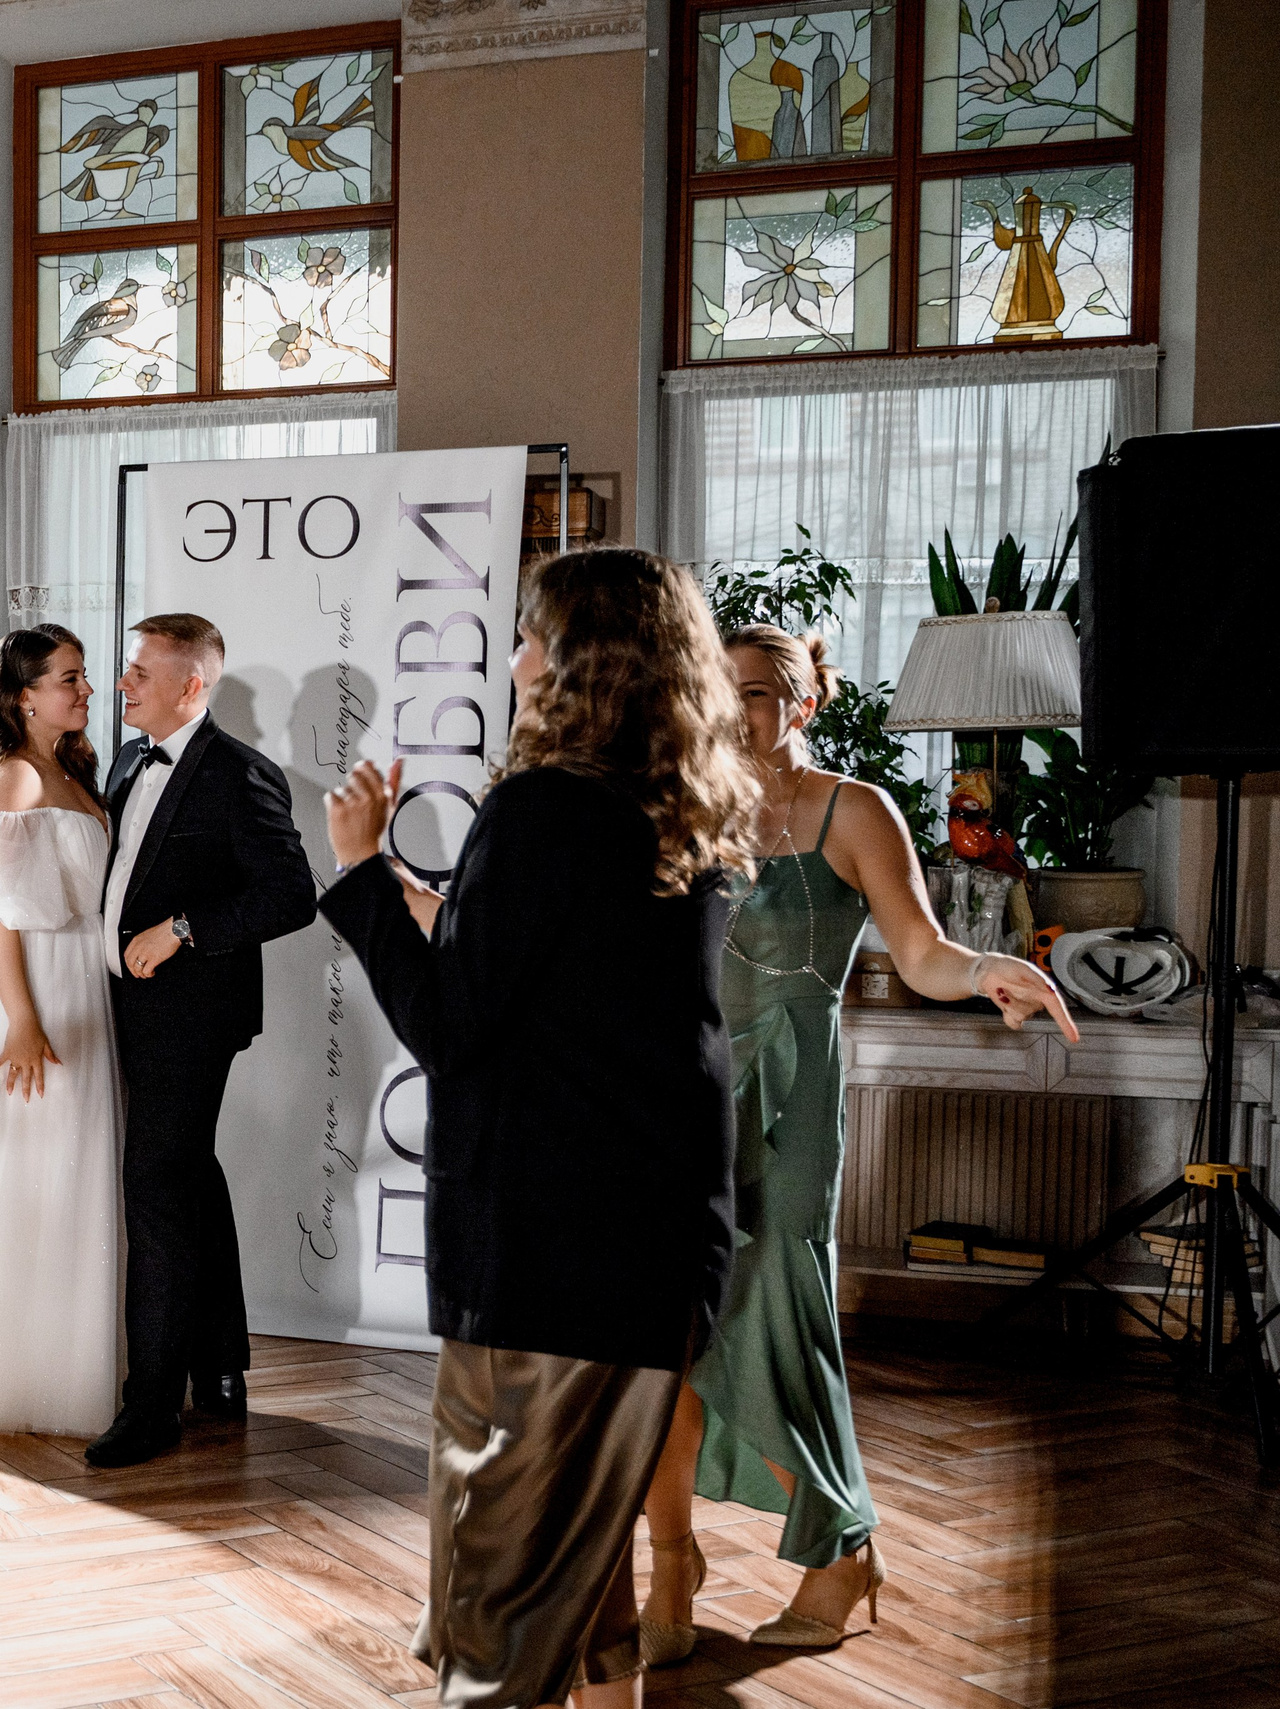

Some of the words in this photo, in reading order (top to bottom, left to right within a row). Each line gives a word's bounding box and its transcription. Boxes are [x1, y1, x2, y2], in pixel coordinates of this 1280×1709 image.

[182, 495, 360, 563] ЭТО
[316, 573, 354, 649] тебе.
[312, 658, 381, 774] благодаря
[388, 488, 492, 893] ЮБВИ
[328, 963, 345, 1025] такое
[328, 1041, 345, 1077] что
[324, 1161, 335, 1178] я
[297, 1188, 338, 1293] Если
